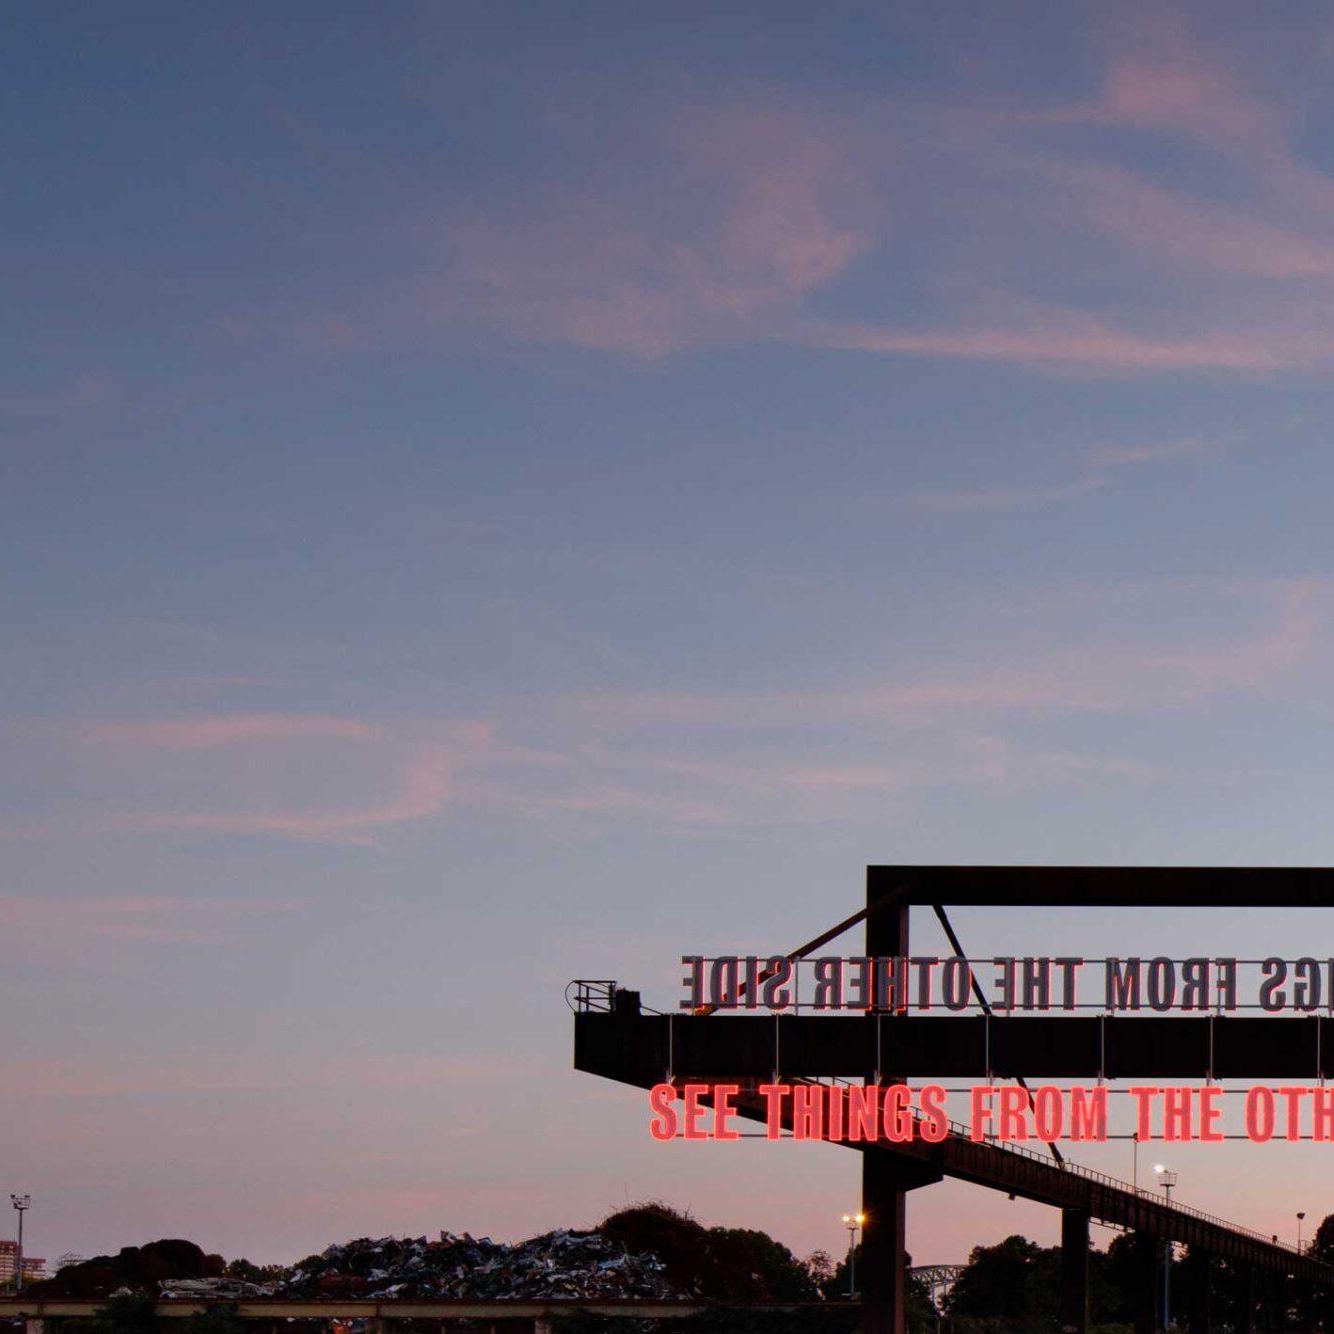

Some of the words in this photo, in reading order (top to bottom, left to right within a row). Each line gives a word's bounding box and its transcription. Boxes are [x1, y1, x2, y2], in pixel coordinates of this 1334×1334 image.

[649, 1083, 741, 1141] SEE
[758, 1083, 949, 1142] THINGS
[970, 1085, 1107, 1143] FROM
[1129, 1086, 1224, 1143] THE
